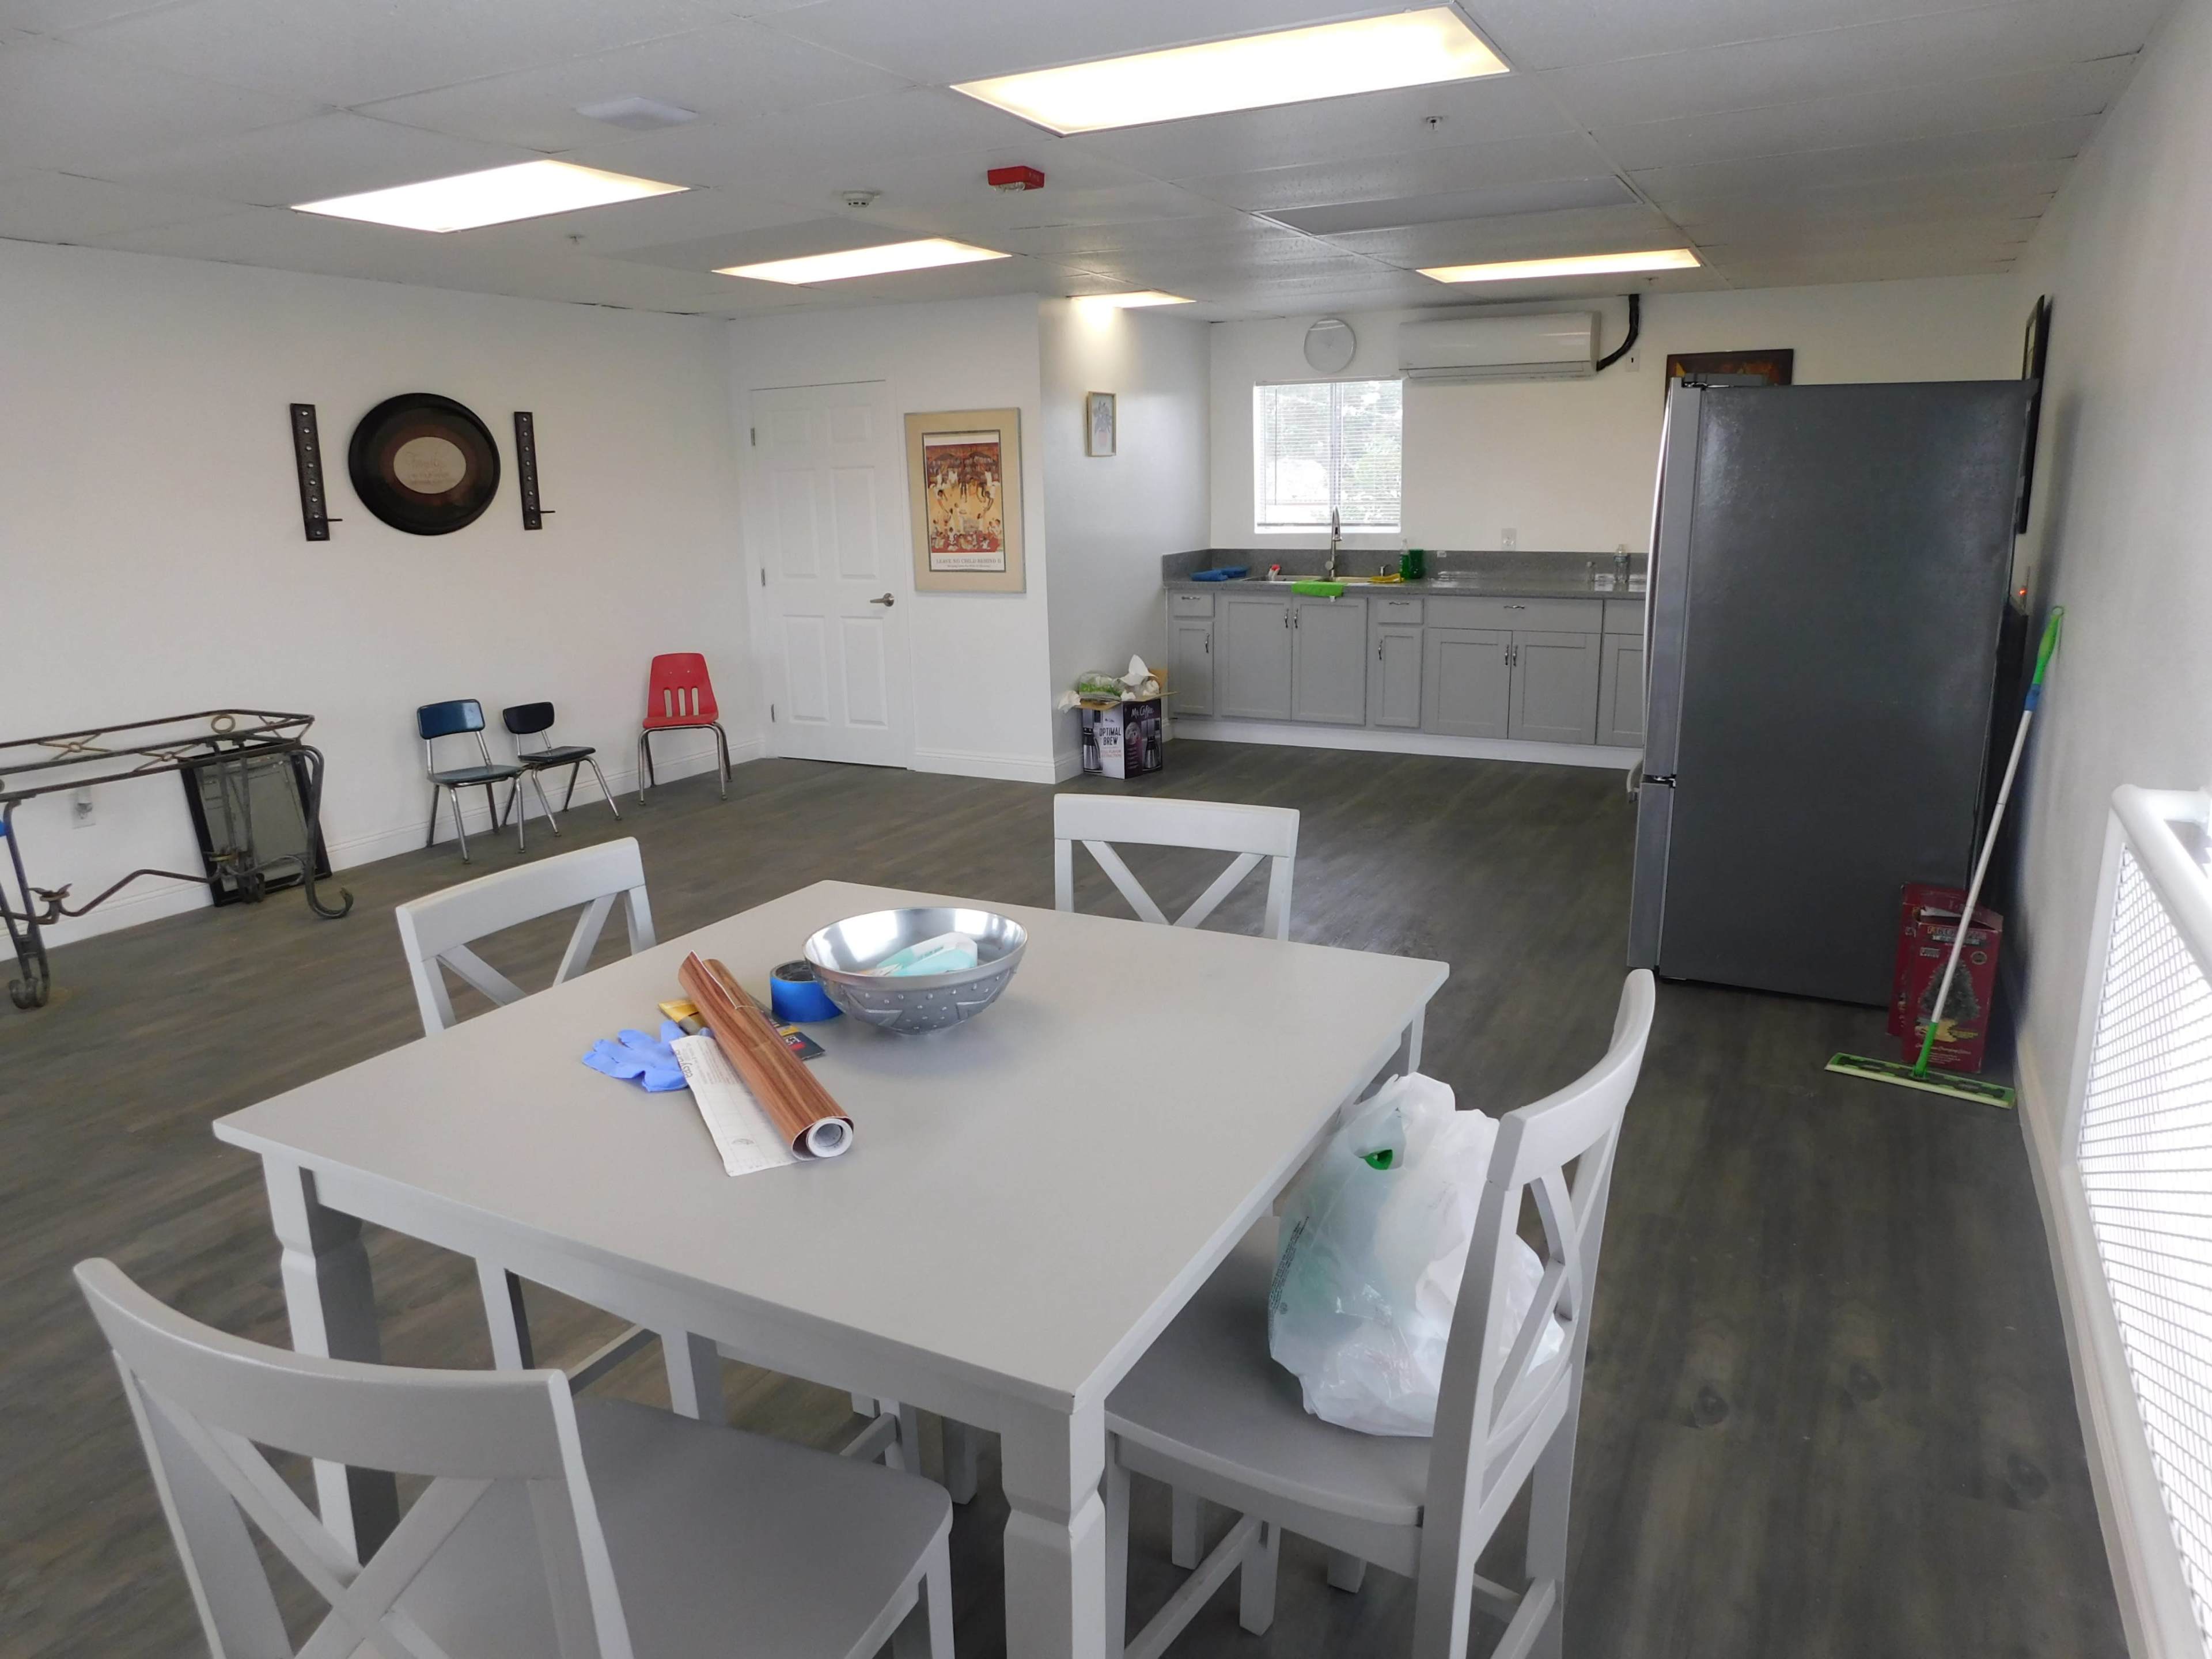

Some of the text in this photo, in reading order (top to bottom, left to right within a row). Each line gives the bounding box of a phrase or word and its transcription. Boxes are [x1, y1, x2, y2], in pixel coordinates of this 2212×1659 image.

[1140, 704, 1154, 719] Coffee
[1099, 727, 1122, 737] OPTIMAL
[1103, 737, 1118, 746] BREW
